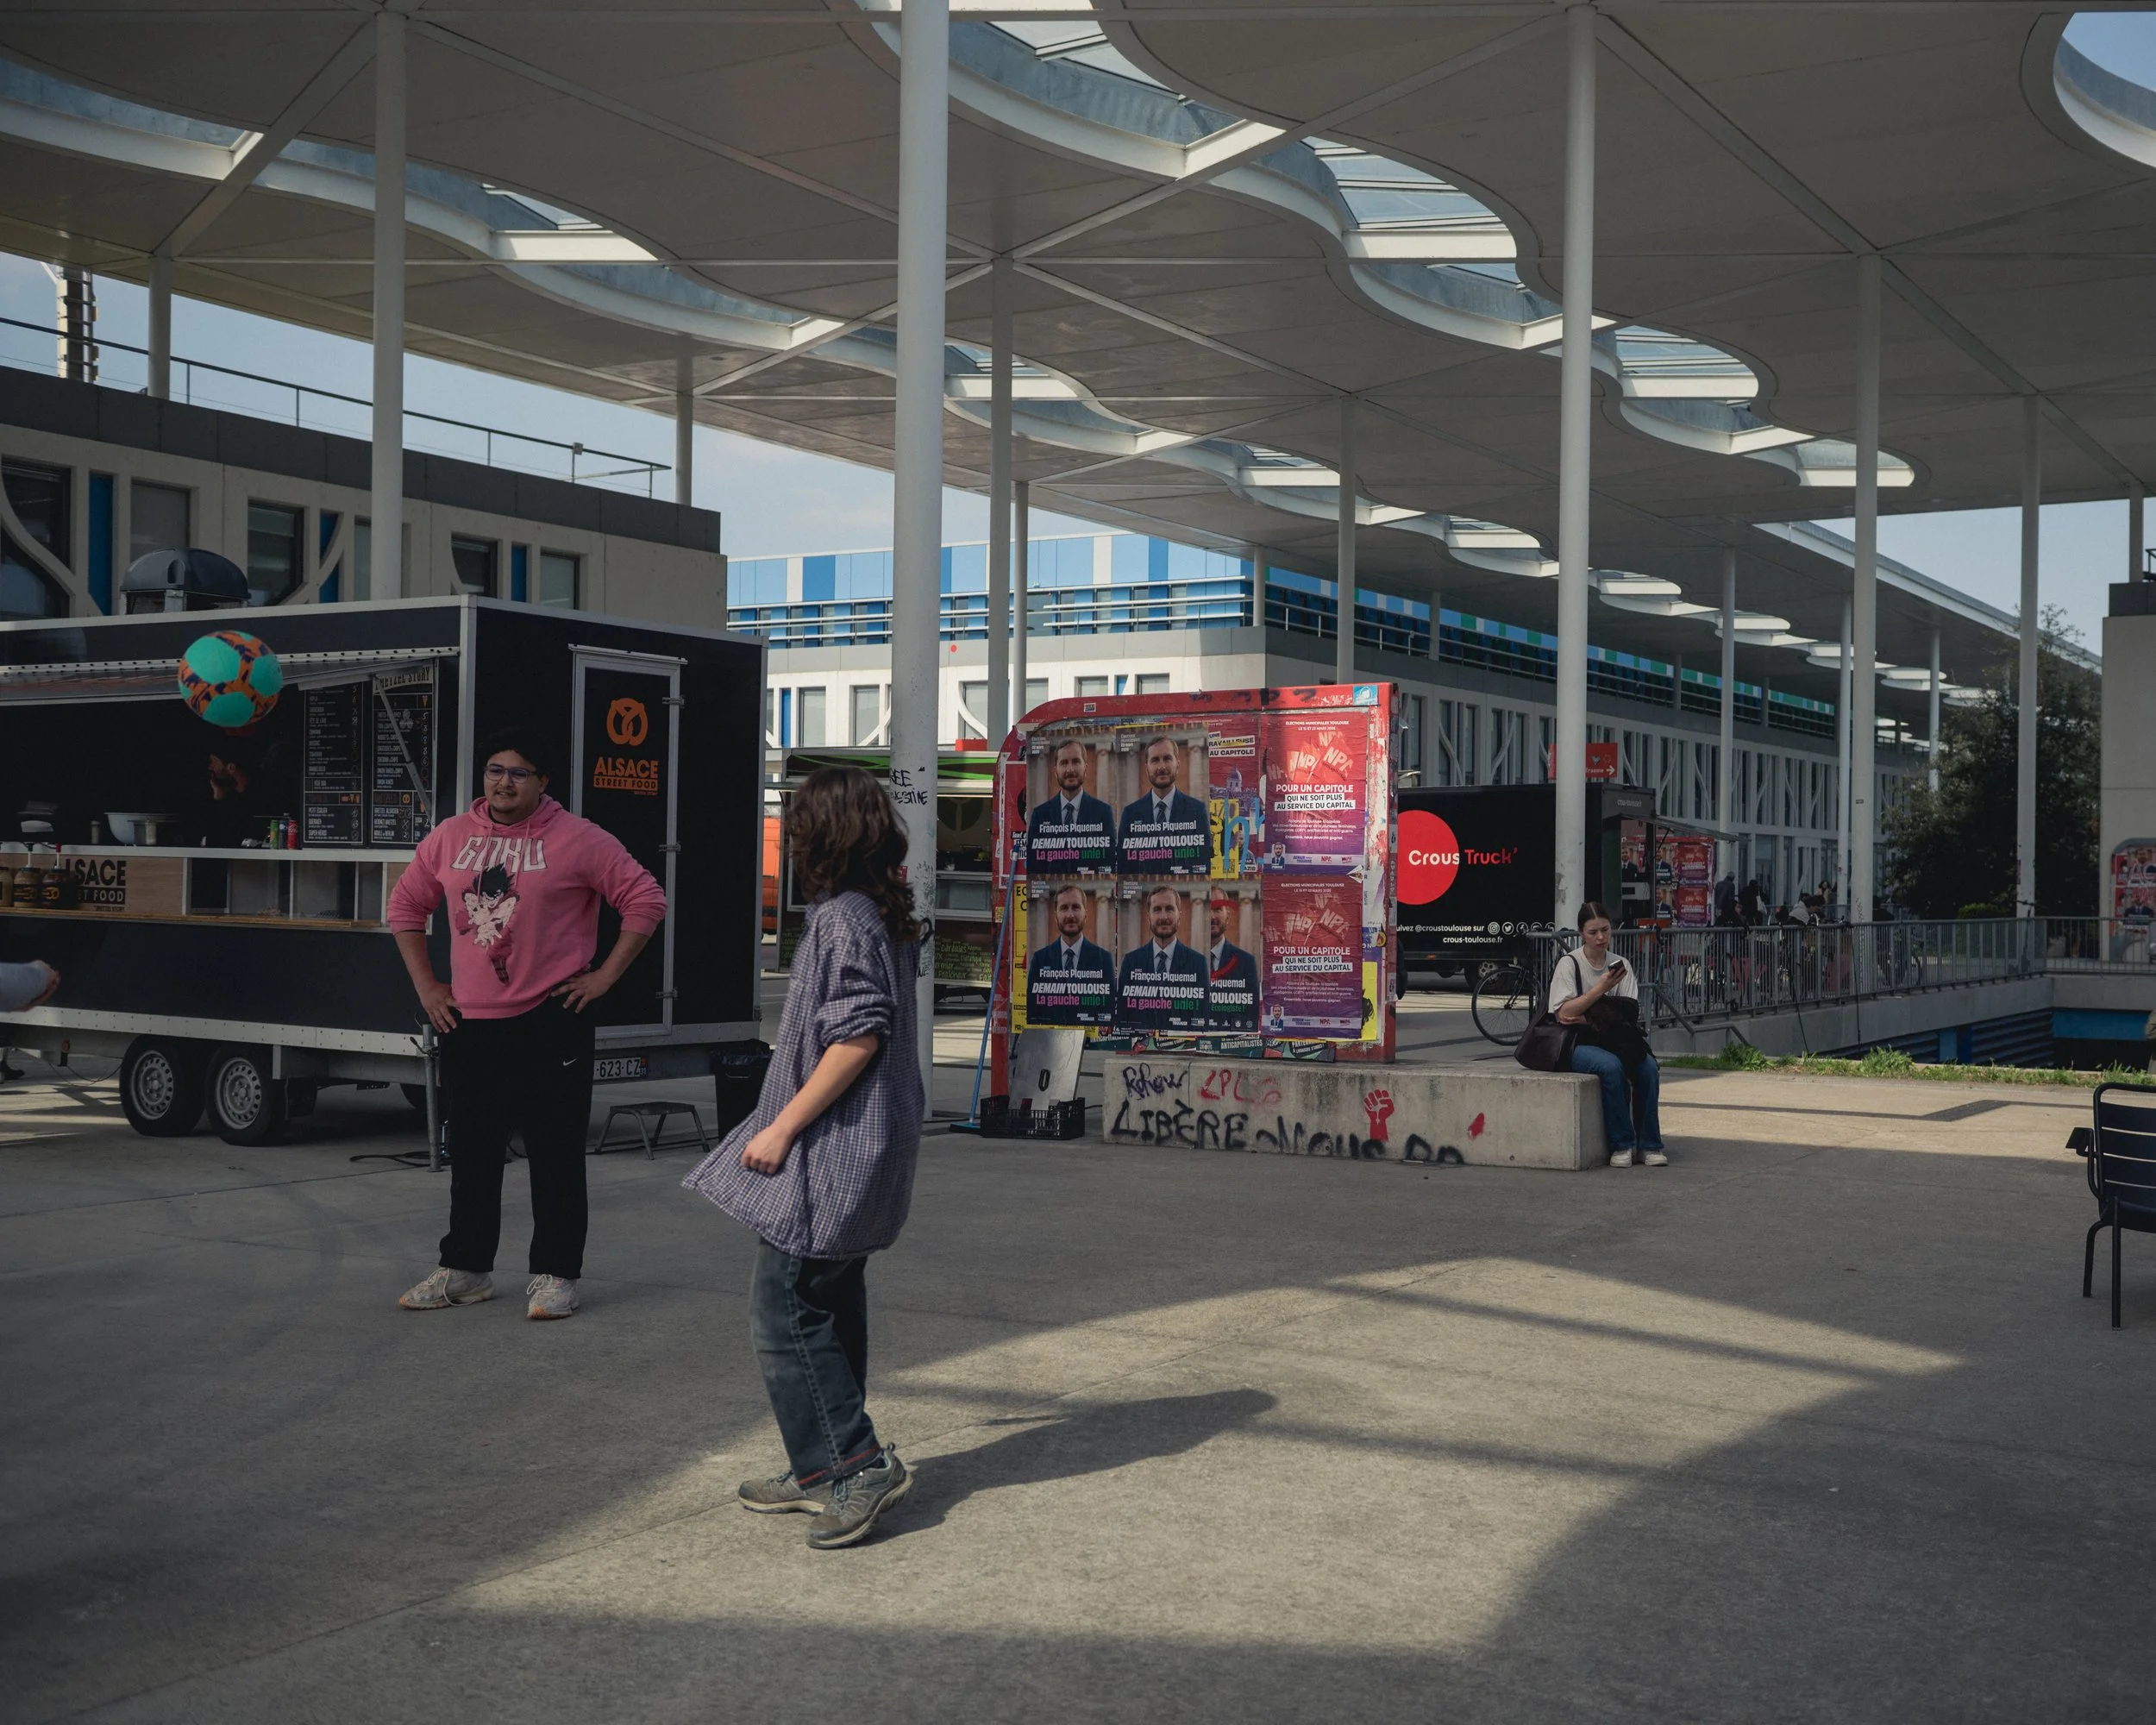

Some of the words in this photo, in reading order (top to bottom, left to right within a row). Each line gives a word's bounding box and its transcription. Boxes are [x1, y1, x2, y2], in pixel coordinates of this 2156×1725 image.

[594, 756, 660, 778] ALSACE
[595, 778, 627, 787] STREET
[632, 780, 656, 788] FOOD
[1276, 784, 1299, 793] POUR
[1314, 783, 1354, 793] CAPITOLE
[1039, 824, 1069, 835] François
[1070, 822, 1103, 833] Piquemal
[1130, 821, 1161, 833] François
[1163, 820, 1196, 831] Piquemal
[1031, 837, 1066, 850] DEMAIN
[1066, 836, 1111, 848] TOULOUSE
[1122, 836, 1158, 849] DEMAIN
[1158, 834, 1205, 846] TOULOUSE
[450, 835, 548, 873] GOKU
[1037, 849, 1045, 860] La
[1047, 849, 1080, 862] gauche
[1081, 848, 1101, 860] unie
[1127, 848, 1137, 860] La
[1138, 847, 1172, 862] gauche
[1174, 846, 1194, 858] unie
[1408, 850, 1460, 866] Crous
[93, 891, 124, 902] FOOD
[1415, 924, 1472, 932] @croustoulouse
[1443, 934, 1503, 944] crous-toulouse.fr
[1274, 946, 1295, 955] POUR
[1312, 946, 1351, 955] CAPITOLE
[1039, 969, 1069, 980] François
[1070, 969, 1103, 980] Piquemal
[1130, 971, 1162, 983] François
[1163, 971, 1196, 983] Piquemal
[1031, 982, 1066, 994] DEMAIN
[1066, 983, 1111, 995] TOULOUSE
[1210, 977, 1245, 988] Piquemal
[1122, 985, 1158, 997] DEMAIN
[1158, 986, 1205, 999] TOULOUSE
[1210, 991, 1253, 1005] OULOUSE
[1037, 994, 1045, 1005] La
[1047, 994, 1080, 1007] gauche
[1081, 994, 1101, 1006] unie
[1126, 996, 1137, 1008] La
[1138, 996, 1172, 1010] gauche
[1174, 998, 1195, 1010] unie
[1220, 1038, 1263, 1050] ANTICAPITALISTES
